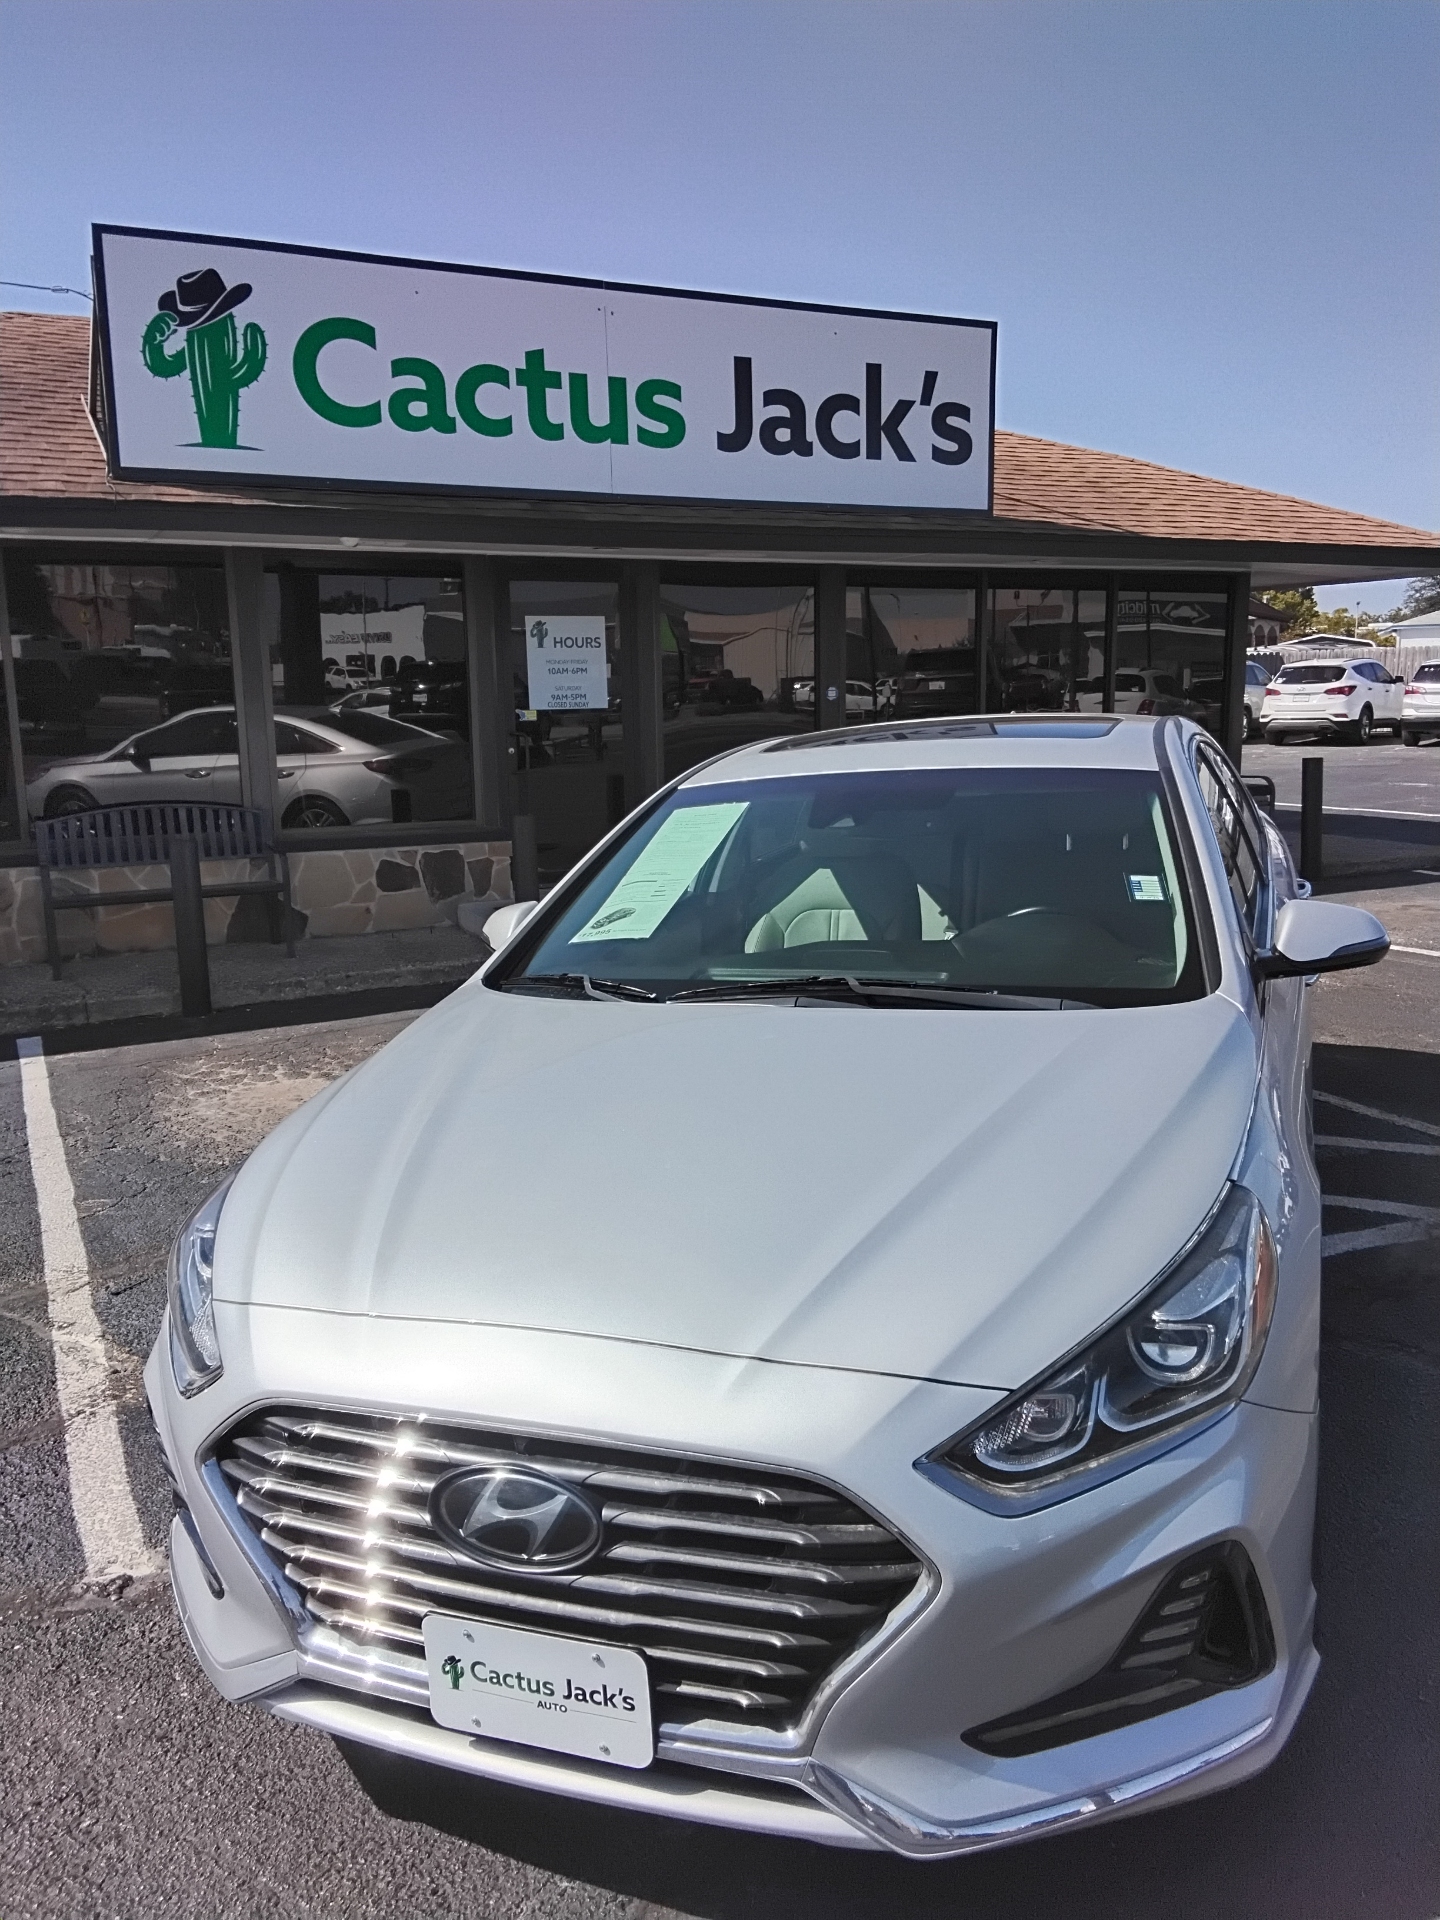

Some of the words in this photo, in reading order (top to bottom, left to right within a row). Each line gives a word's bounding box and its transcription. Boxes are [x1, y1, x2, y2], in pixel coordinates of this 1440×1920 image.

[292, 316, 687, 449] Cactus
[716, 355, 973, 466] Jack's
[553, 637, 601, 648] HOURS
[547, 667, 588, 675] 10AM-6PM
[470, 1660, 555, 1697] Cactus
[562, 1678, 636, 1712] Jack's
[537, 1700, 568, 1713] AUTO
